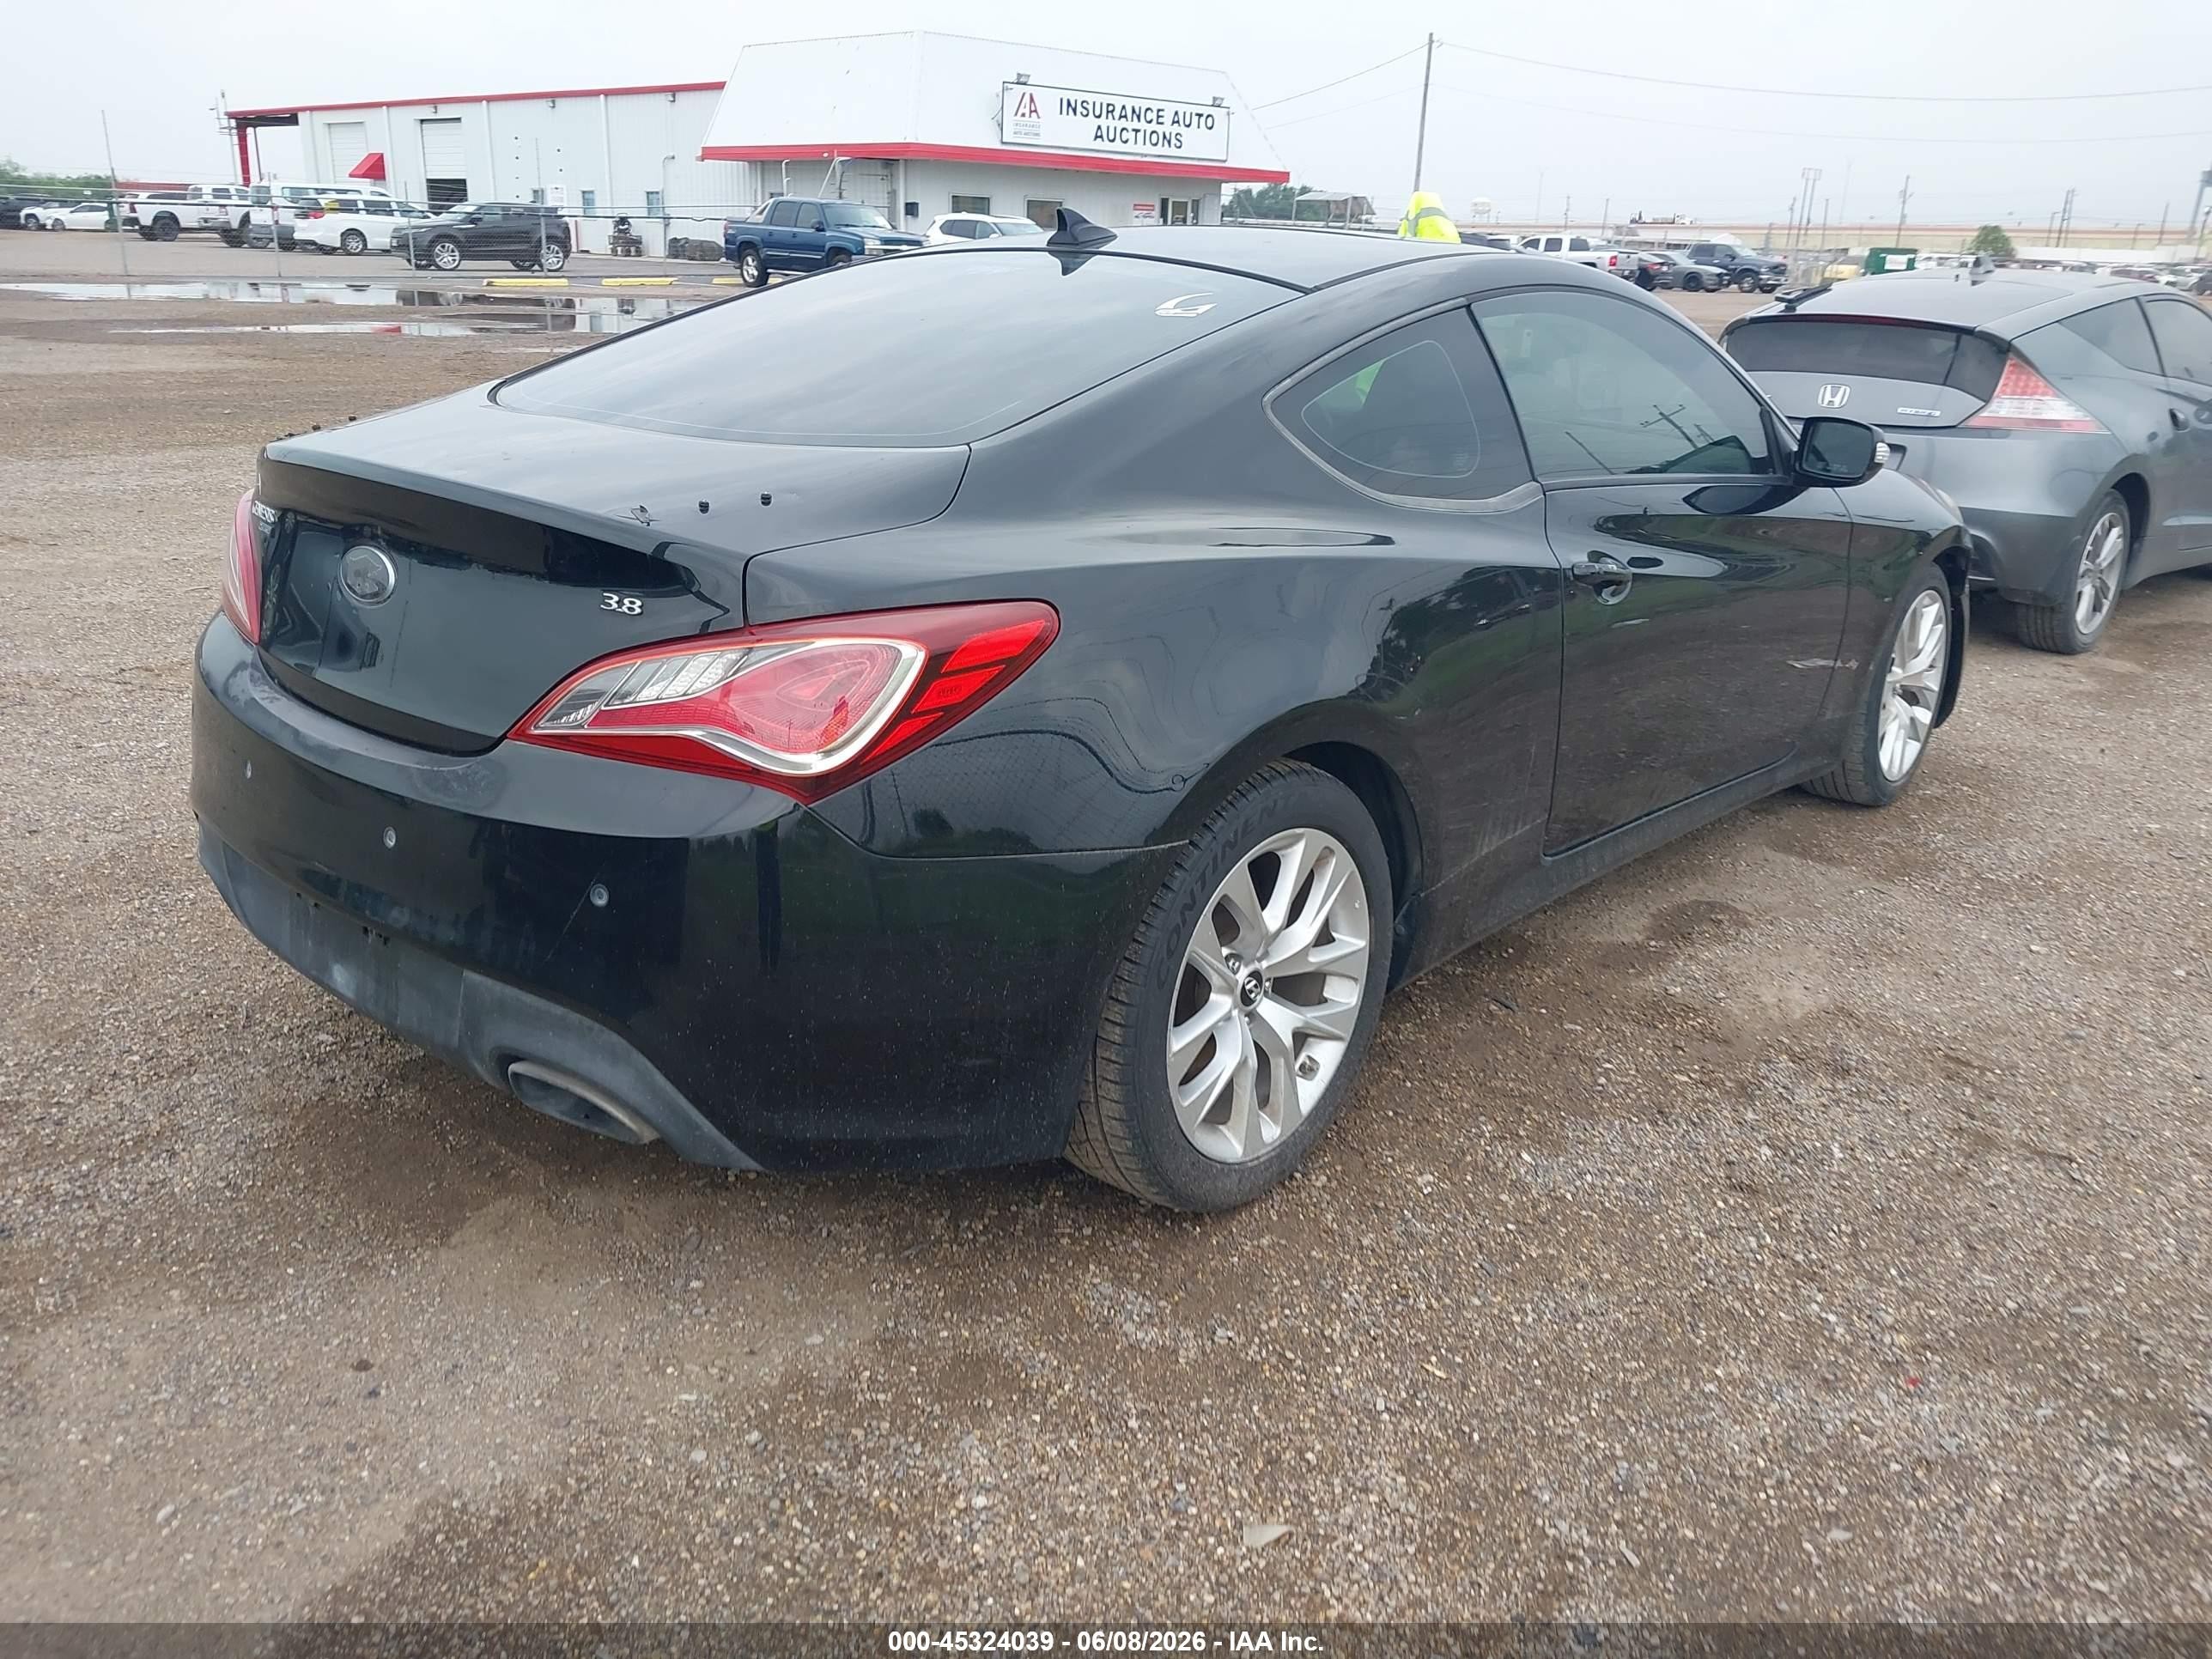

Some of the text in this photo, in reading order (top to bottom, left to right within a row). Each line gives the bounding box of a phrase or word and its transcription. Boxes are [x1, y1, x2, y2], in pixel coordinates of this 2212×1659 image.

[1059, 97, 1215, 131] INSURANCE AUTO
[1093, 125, 1183, 149] AUCTIONS
[1157, 790, 1300, 990] CONTINEN
